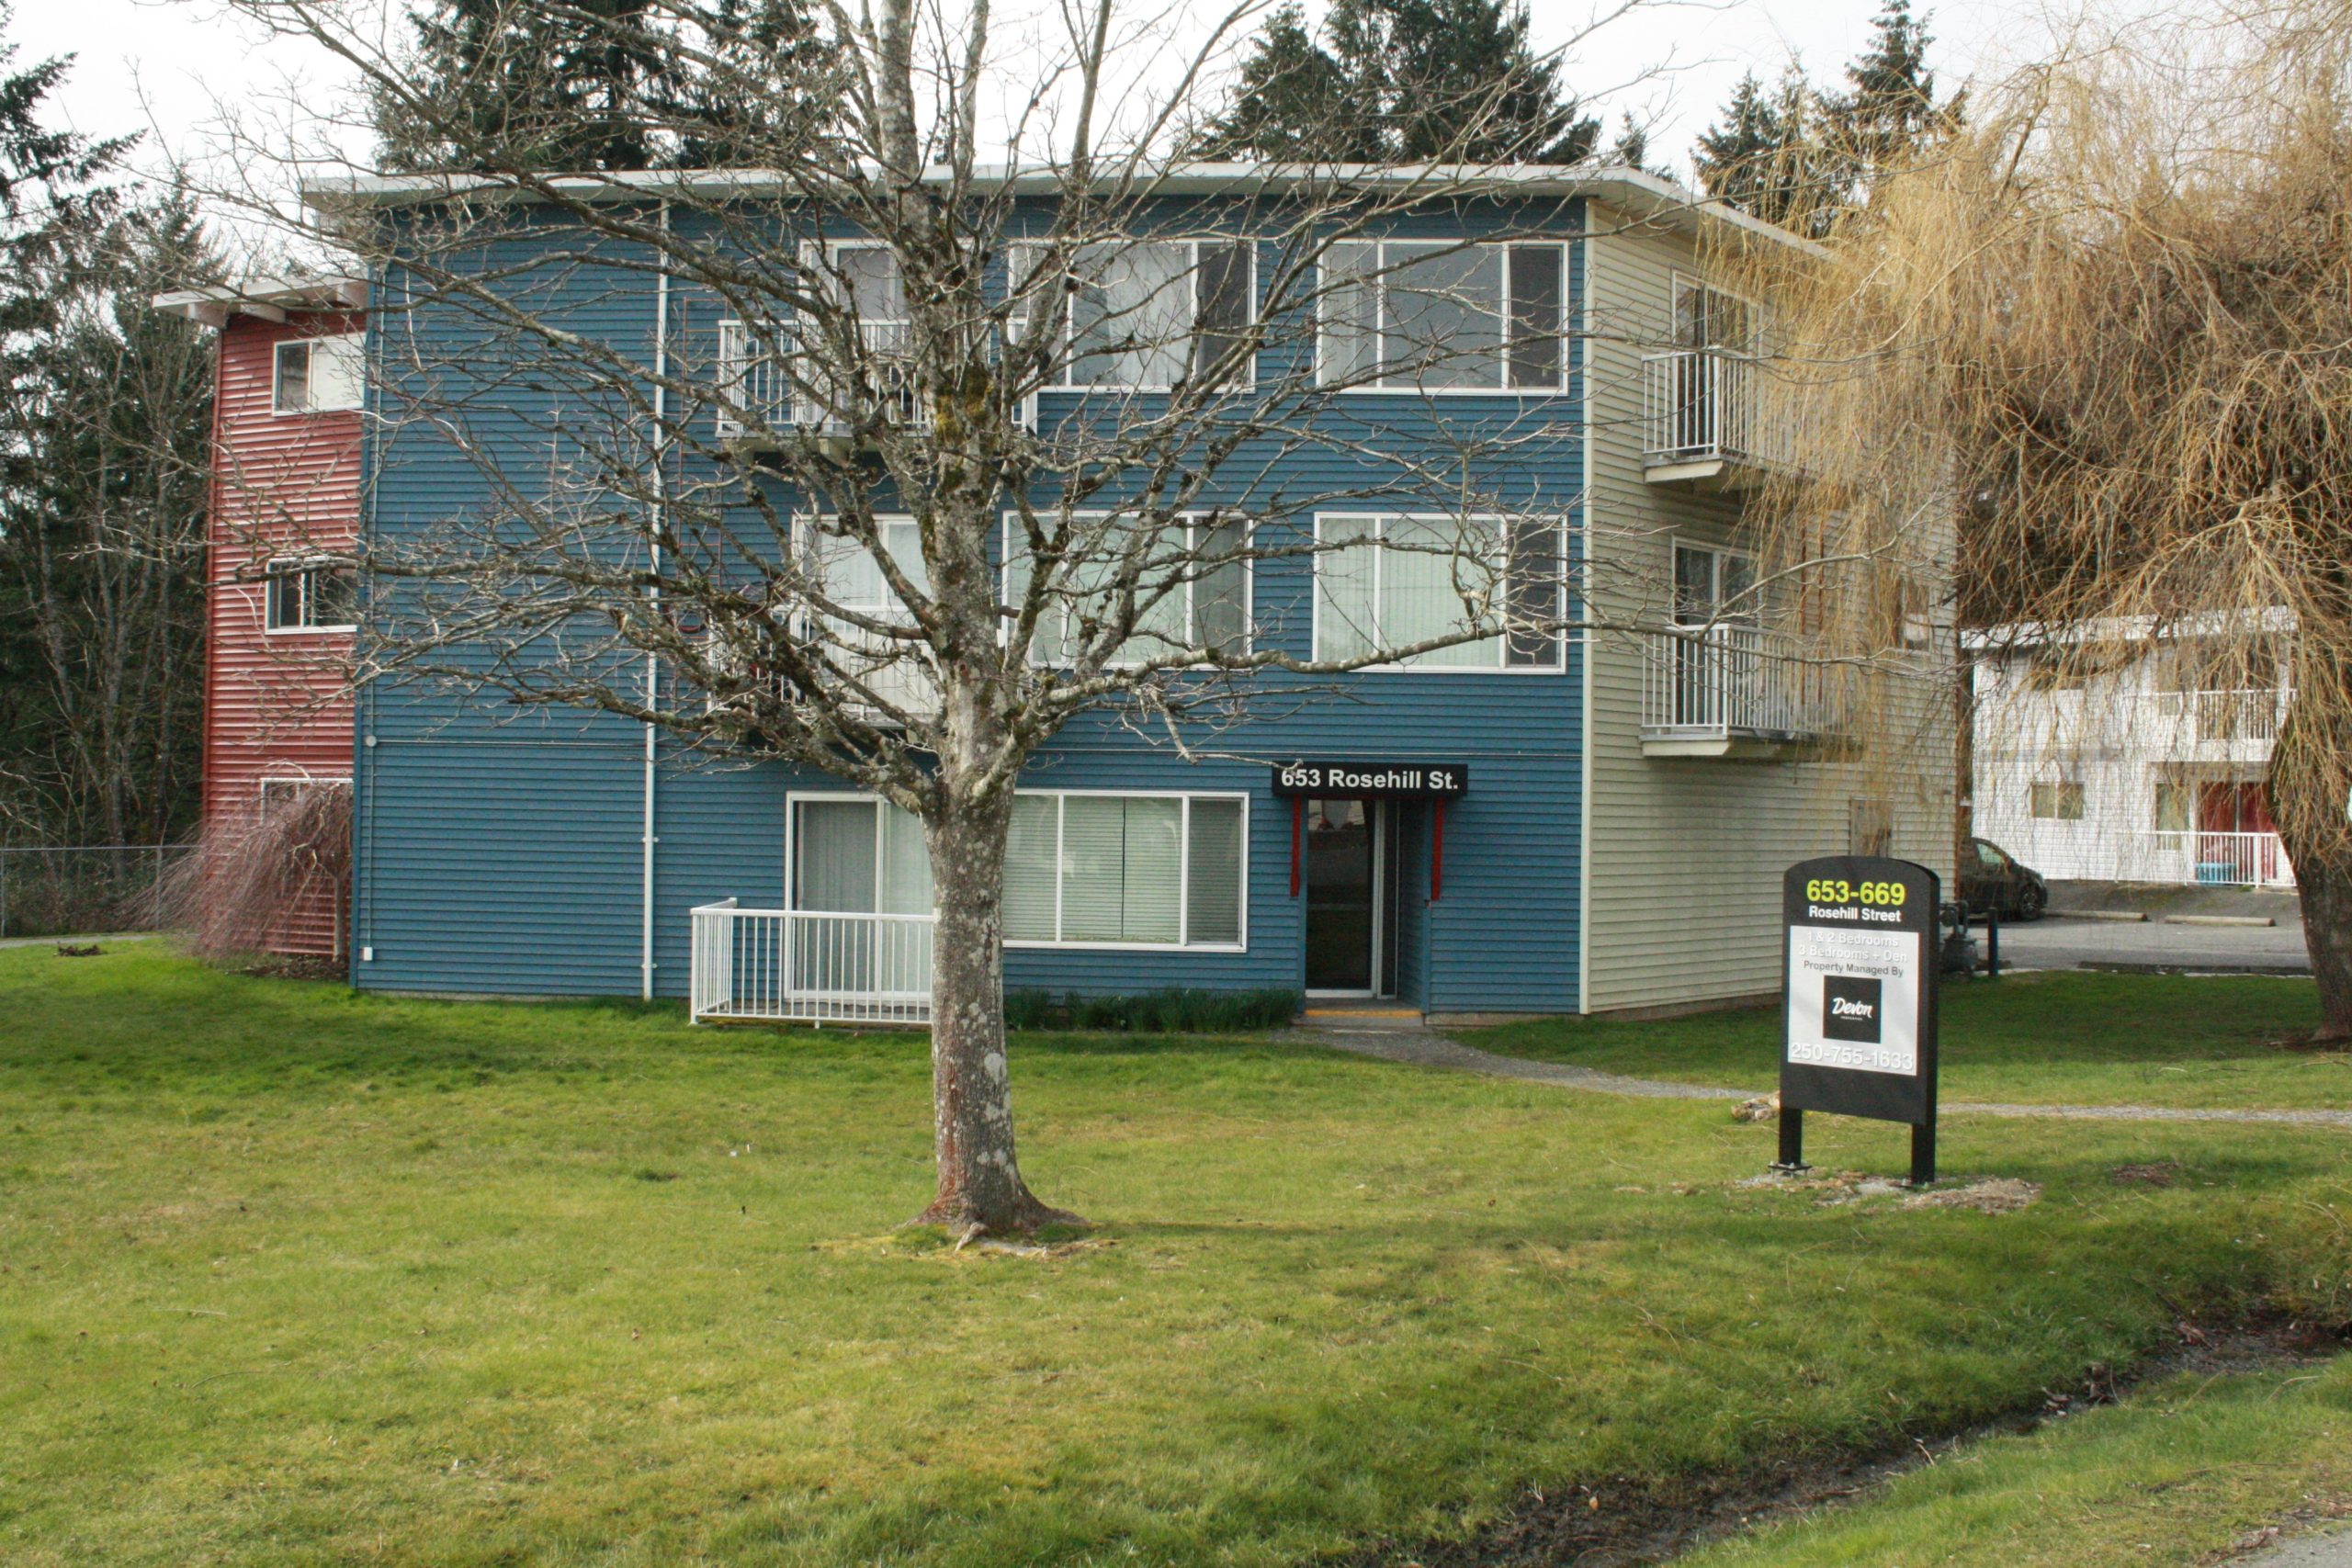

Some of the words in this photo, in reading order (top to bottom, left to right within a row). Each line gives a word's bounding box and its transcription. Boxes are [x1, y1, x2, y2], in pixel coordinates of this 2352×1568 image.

[1281, 768, 1321, 787] 653
[1329, 769, 1421, 789] Rosehill
[1429, 771, 1459, 790] St.
[1806, 879, 1906, 906] 653-669
[1809, 905, 1858, 920] Rosehill
[1861, 908, 1902, 922] Street
[1807, 931, 1814, 942] 1
[1826, 931, 1836, 943] 2
[1838, 931, 1900, 948] Bedrooms
[1809, 945, 1870, 961] Bedrooms
[1883, 949, 1909, 964] Den
[1804, 960, 1845, 974] Property
[1846, 963, 1890, 976] Managed
[1891, 965, 1904, 978] By
[1832, 997, 1873, 1019] Devon
[1792, 1041, 1915, 1072] 250-755-1633
